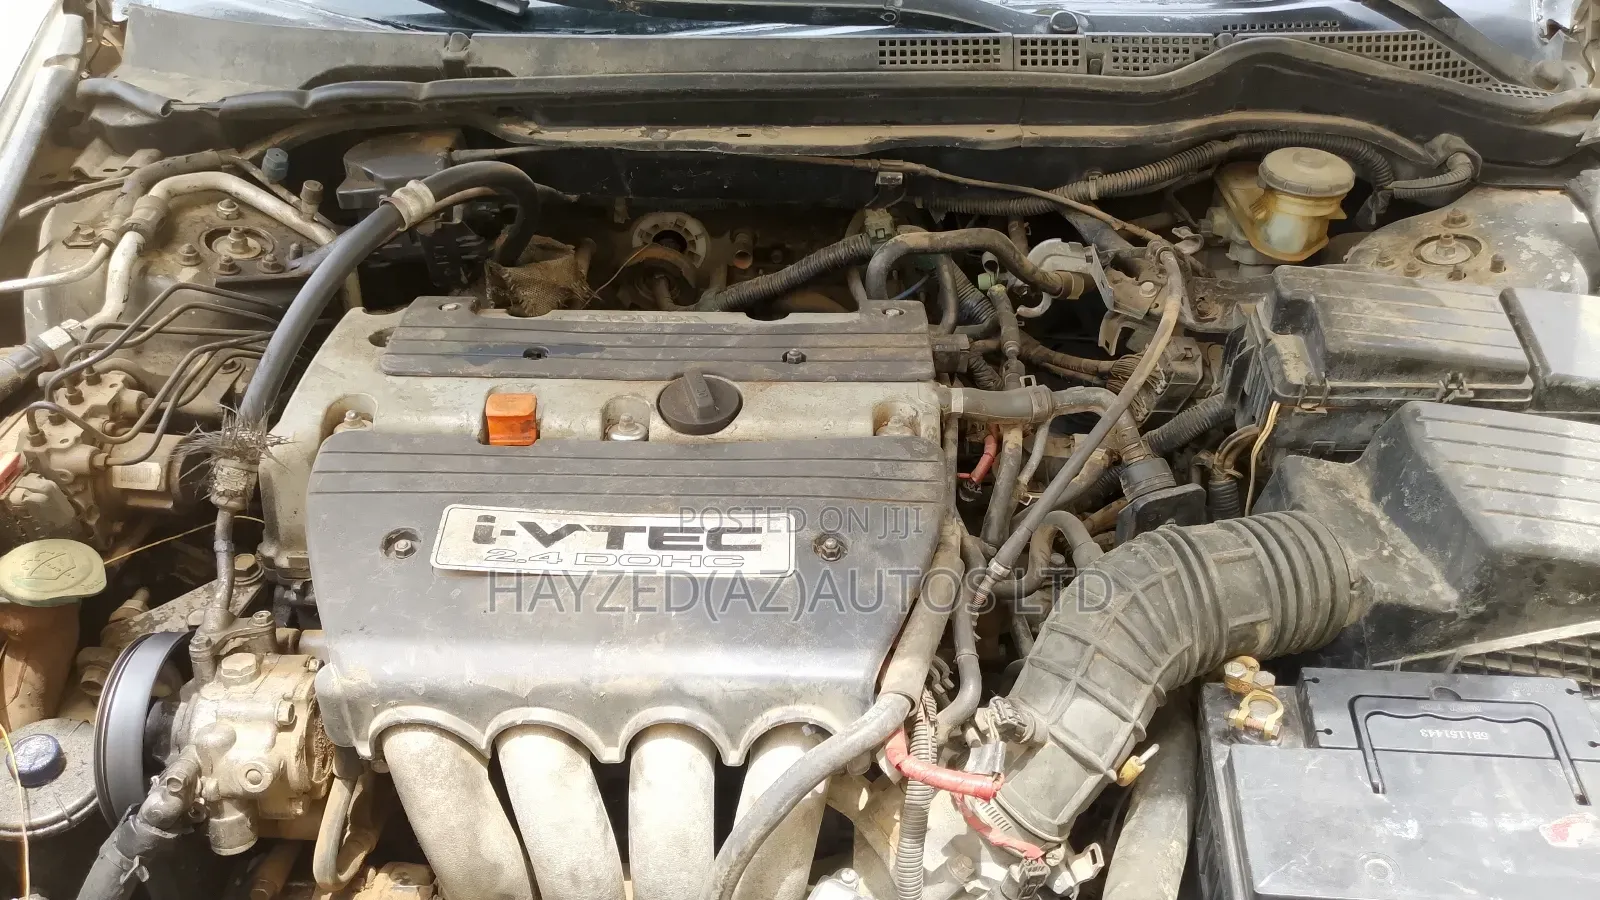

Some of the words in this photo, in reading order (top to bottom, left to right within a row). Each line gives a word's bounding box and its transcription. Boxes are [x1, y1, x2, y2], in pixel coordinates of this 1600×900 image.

[472, 514, 763, 551] i-VTEC
[484, 549, 563, 564] 2.4
[575, 553, 745, 567] DOHC
